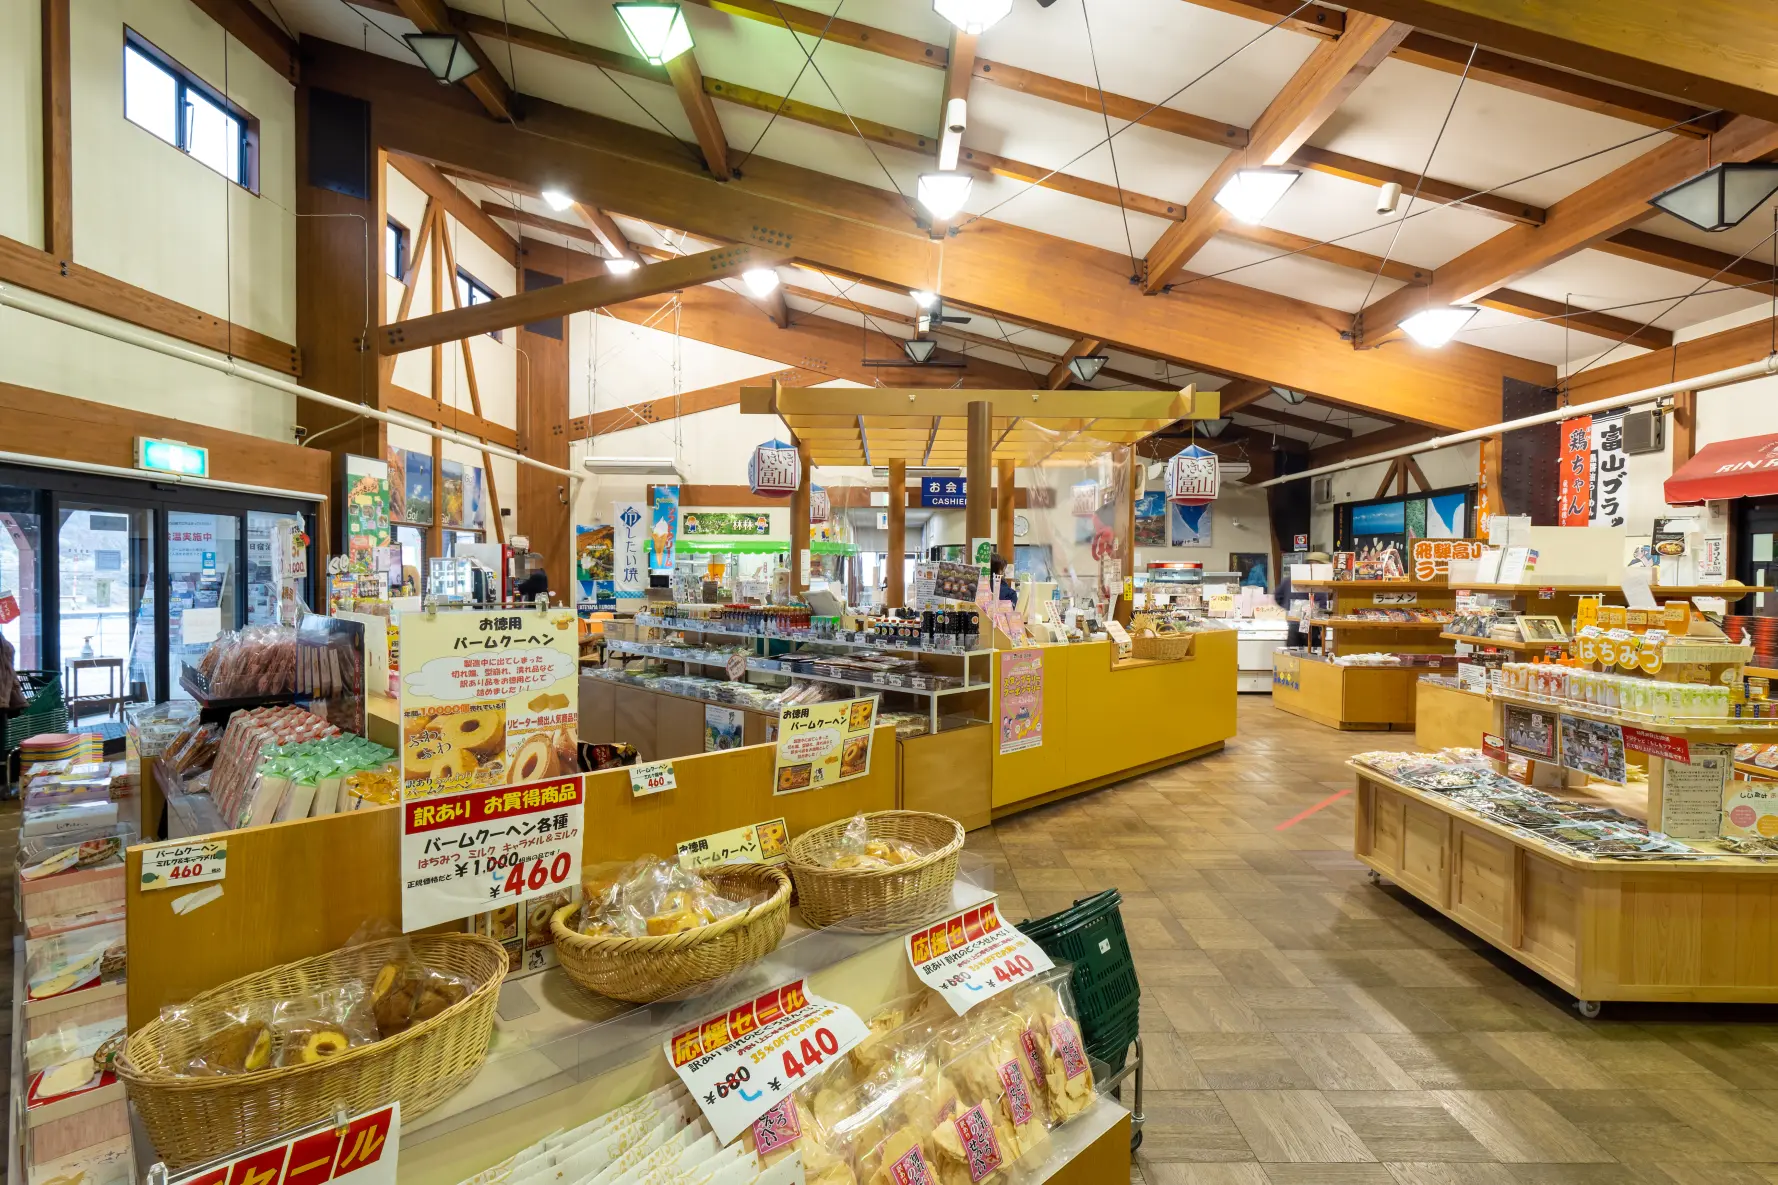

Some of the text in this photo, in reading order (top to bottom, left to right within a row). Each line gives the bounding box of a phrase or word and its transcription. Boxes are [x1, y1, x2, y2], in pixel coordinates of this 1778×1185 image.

[761, 466, 794, 485] 富山
[1180, 460, 1214, 475] いきいき
[1567, 428, 1589, 516] 鶏ちゃん
[1179, 475, 1214, 494] 富山
[1375, 594, 1416, 603] ラーメン
[478, 616, 523, 631] お徳用
[453, 633, 555, 650] バームクーヘン
[463, 655, 543, 668] 製造中に出てしまった
[1579, 640, 1660, 668] はちみつ
[459, 674, 547, 688] 訳あり品をお徳用として
[783, 708, 809, 720] お徳用
[790, 716, 847, 731] バームクーヘン
[648, 776, 665, 788] 460
[413, 783, 577, 828] 訳あり お買得商品
[423, 812, 569, 855] バームクーヘン各種
[155, 844, 219, 859] バームクーヘン
[417, 828, 578, 870] はちみつ ミルク キャラメル&ミルク
[169, 863, 203, 880] 460
[406, 873, 453, 889] 正規価格だと
[912, 909, 998, 965] 応援セール
[922, 960, 946, 976] 訳あり
[674, 989, 806, 1066] 応援セール
[687, 1049, 723, 1073] 訳あり
